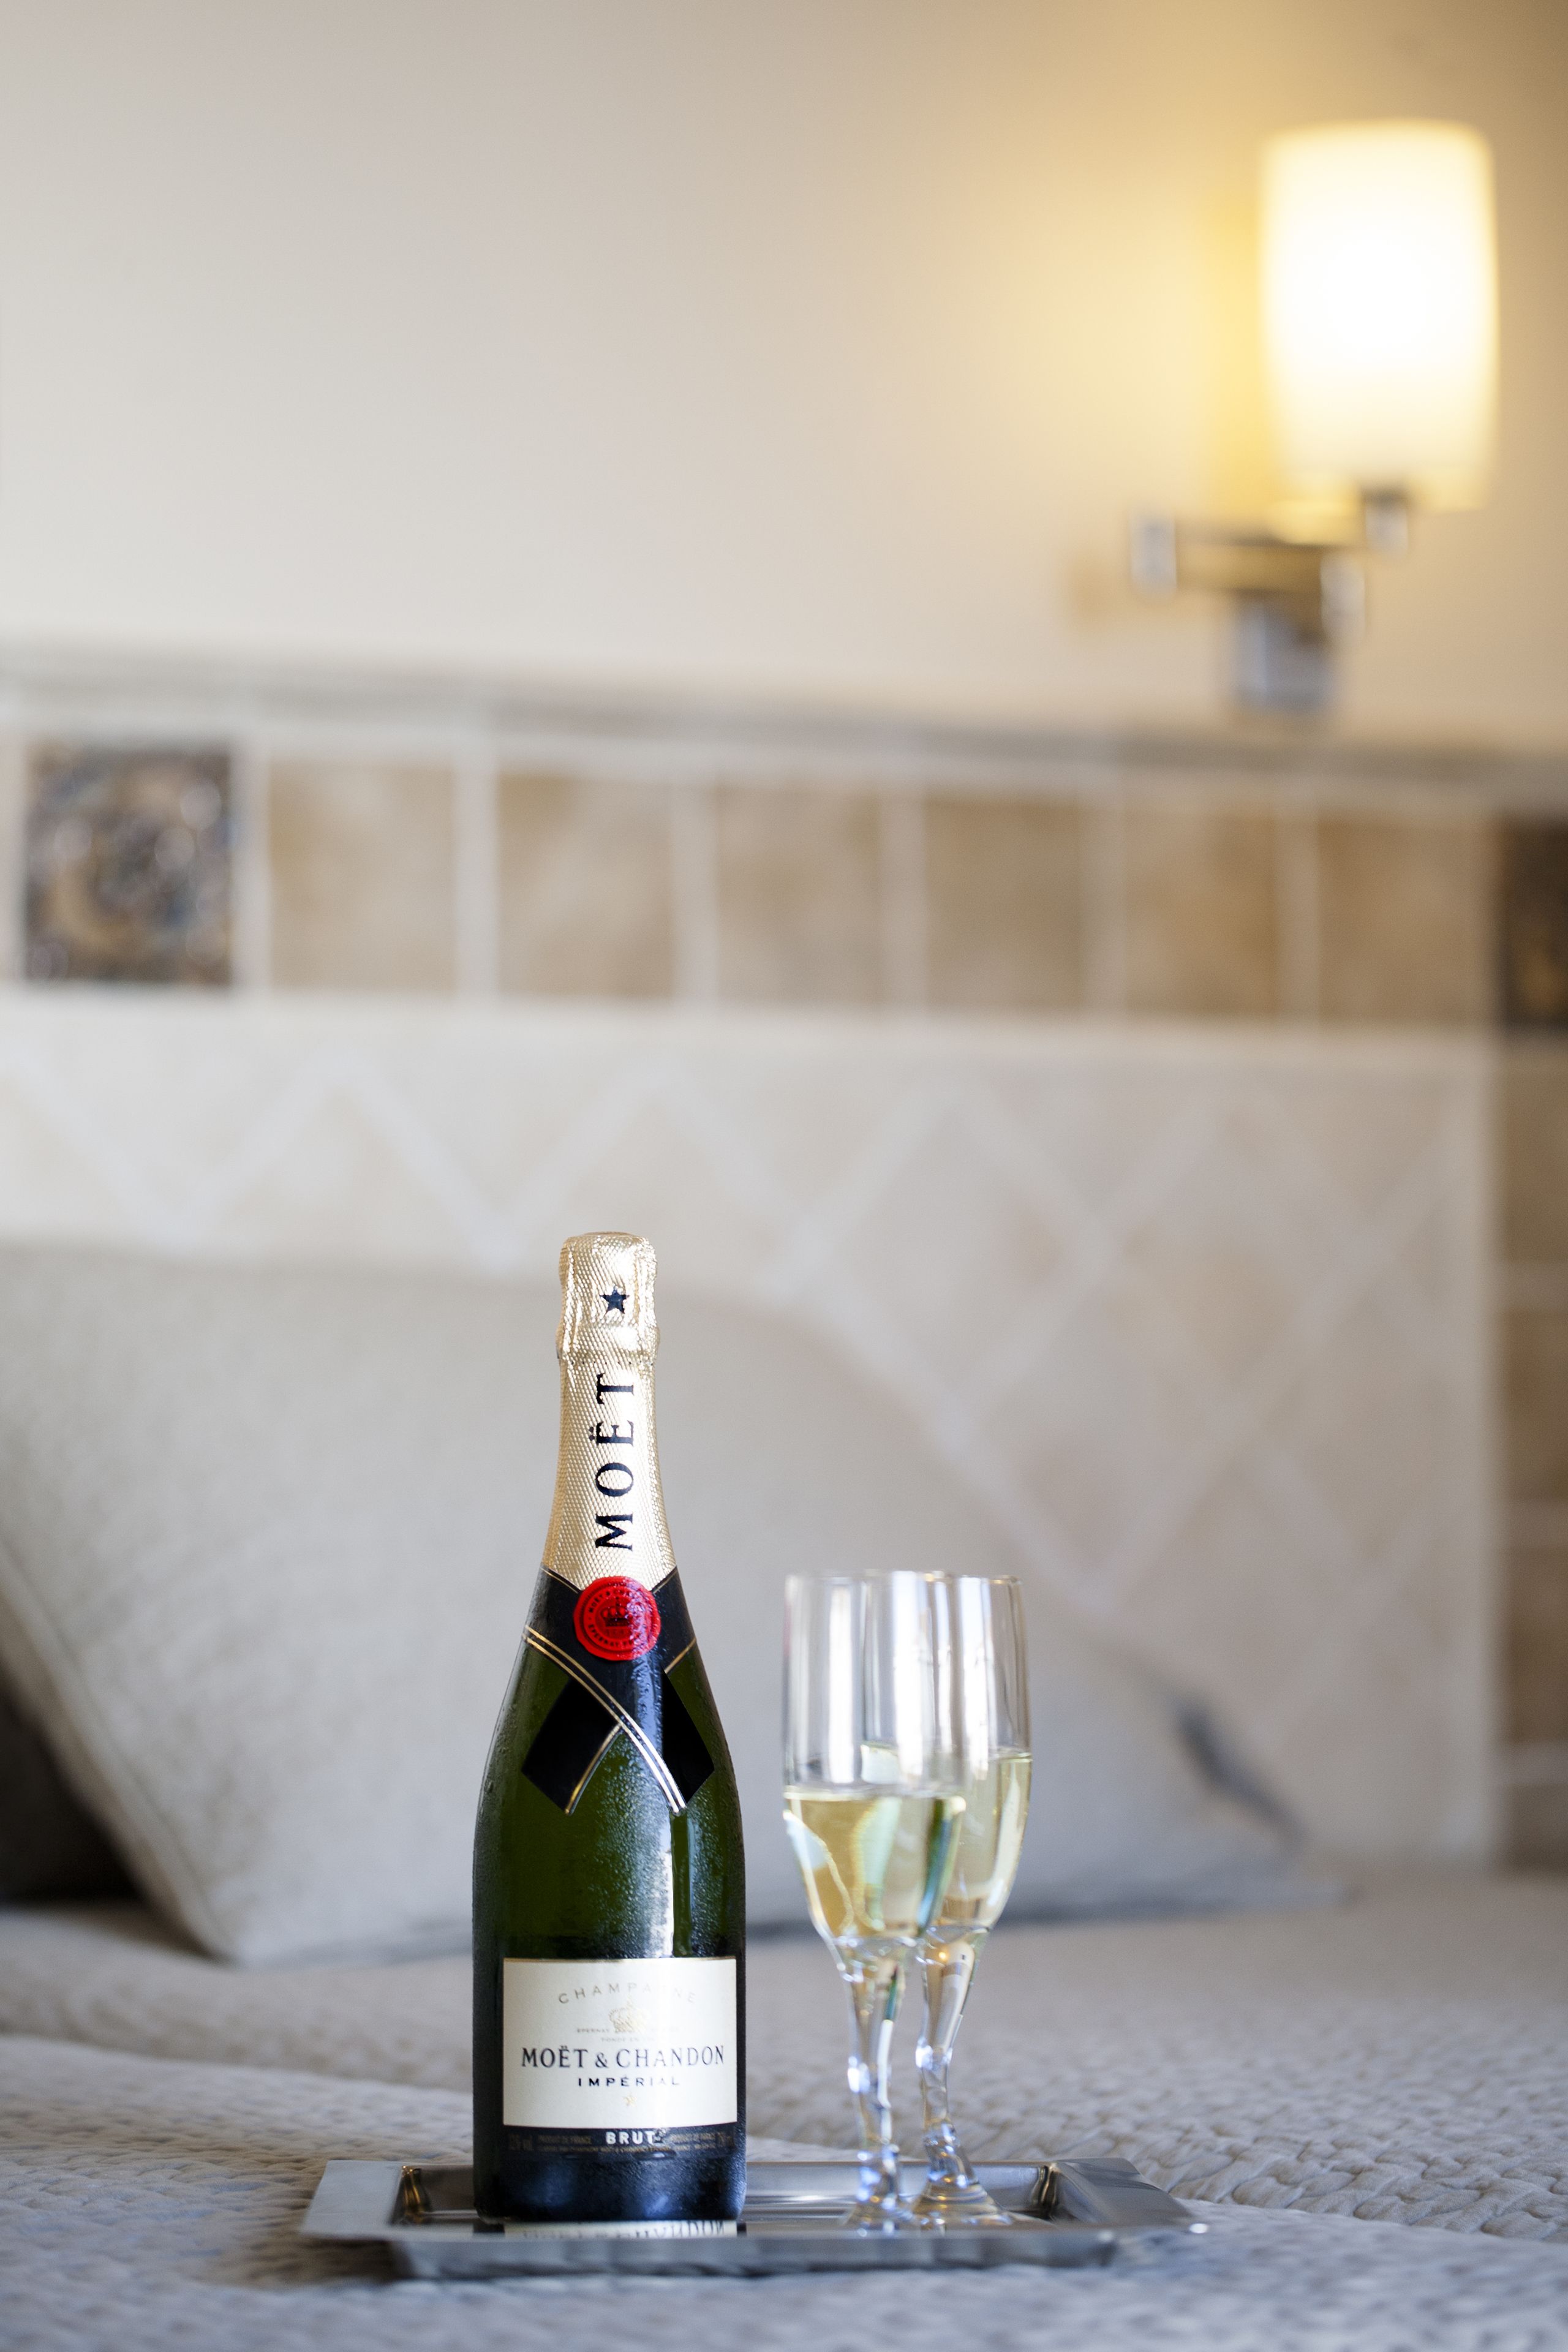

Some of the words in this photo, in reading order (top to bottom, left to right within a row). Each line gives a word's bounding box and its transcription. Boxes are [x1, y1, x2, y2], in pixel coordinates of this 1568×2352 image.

[589, 1373, 634, 1551] MOËT
[558, 1982, 696, 2005] CHAMPANE
[521, 2045, 589, 2068] MOËT
[595, 2051, 609, 2068] &
[616, 2045, 725, 2068] CHANDON
[578, 2076, 680, 2087] IMPÉRIAL
[605, 2131, 655, 2145] BRUT
